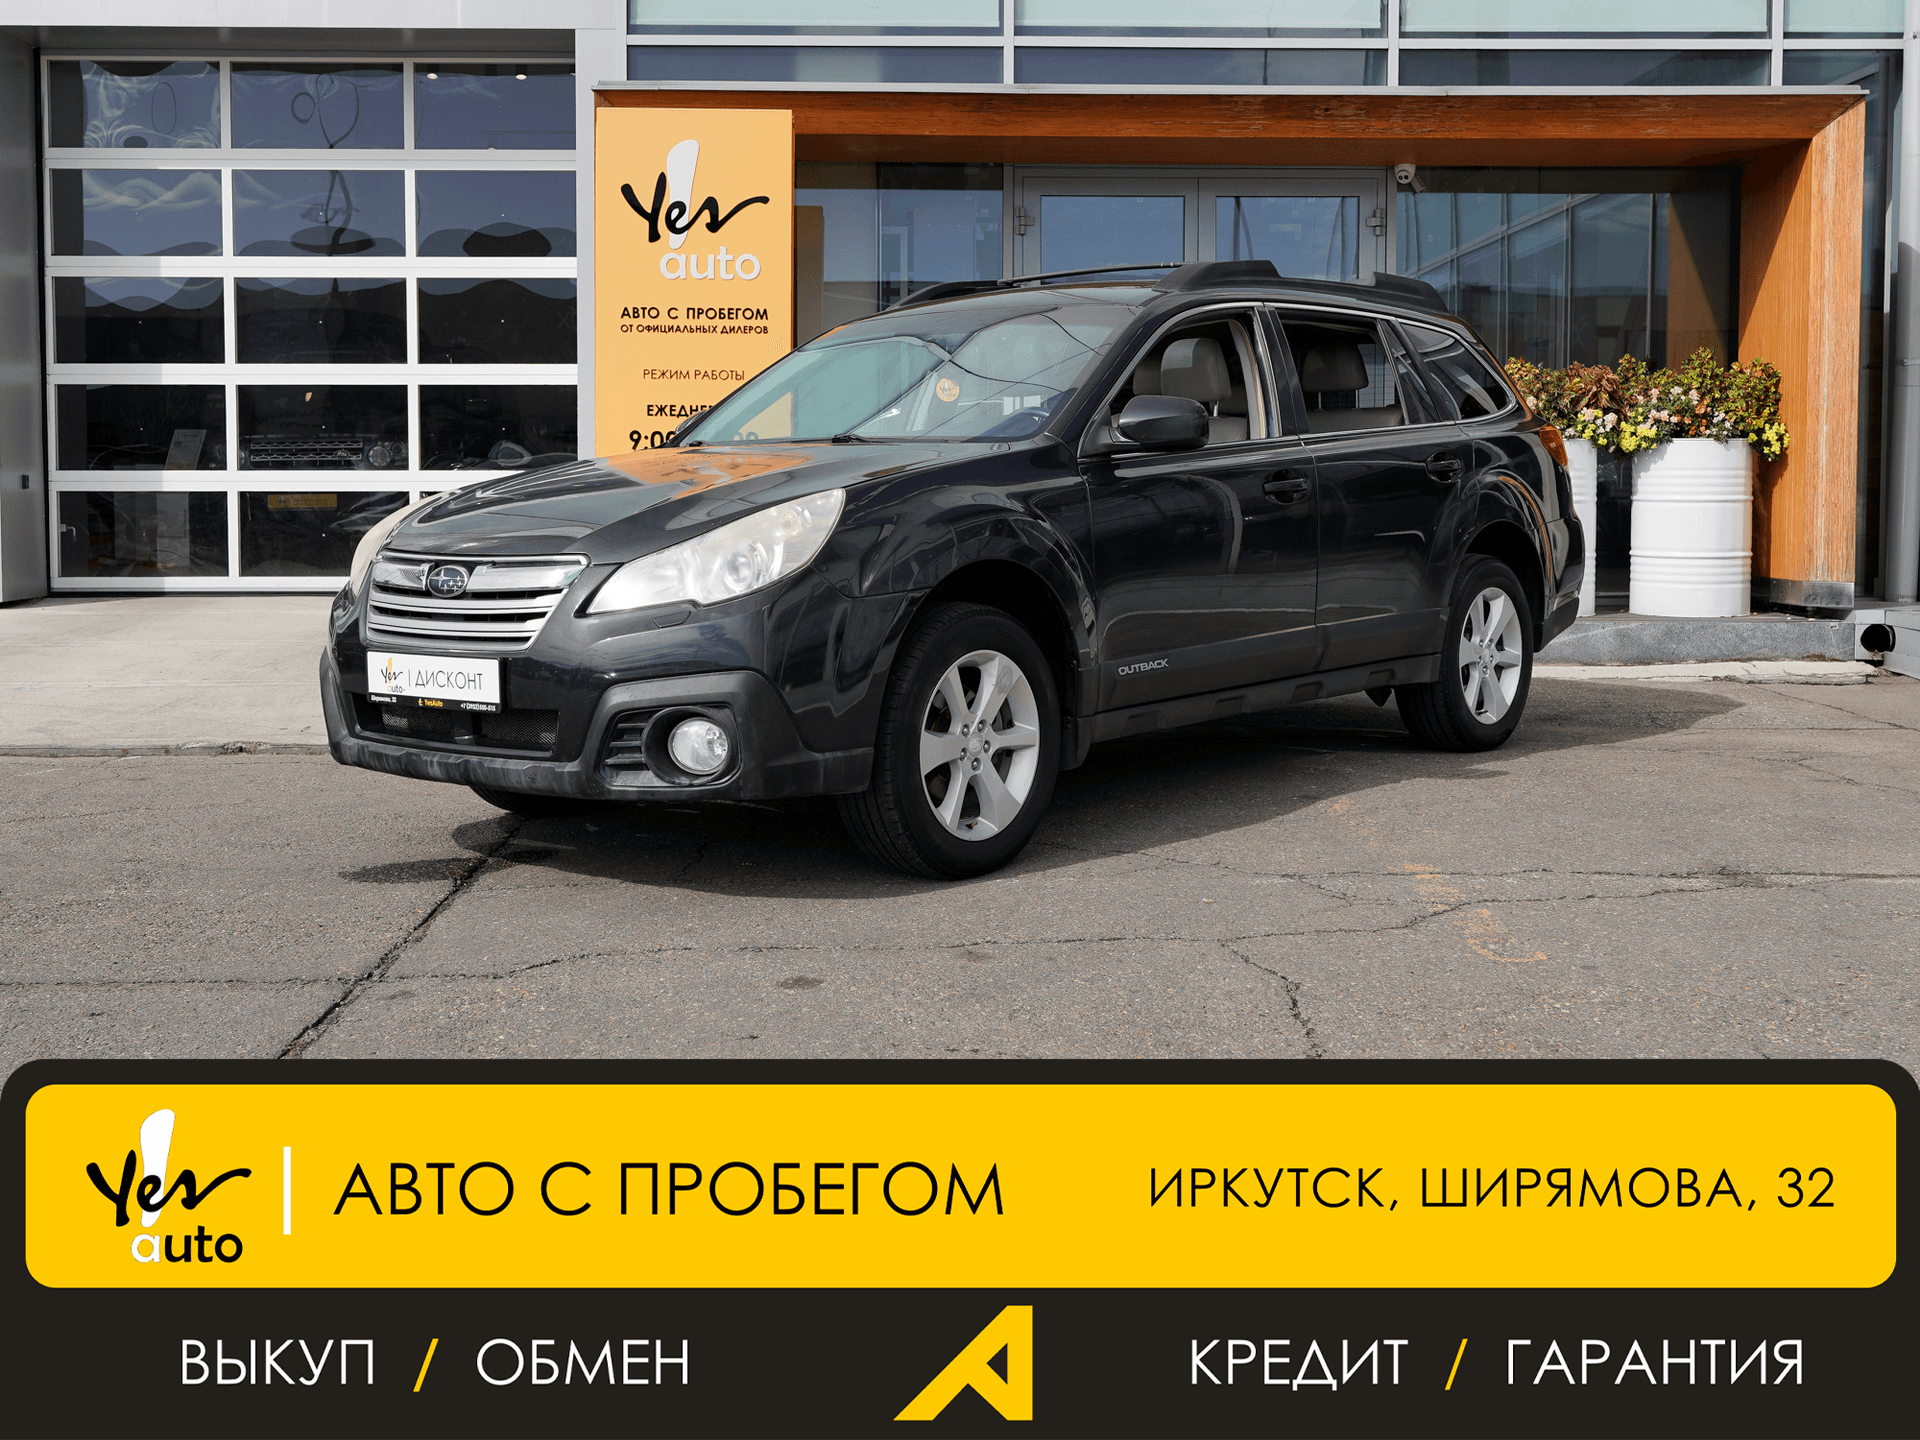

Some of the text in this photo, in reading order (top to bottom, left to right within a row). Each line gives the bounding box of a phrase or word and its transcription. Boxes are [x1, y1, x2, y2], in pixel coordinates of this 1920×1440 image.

[620, 170, 770, 243] Yes
[659, 246, 761, 280] auto
[620, 306, 769, 321] АВТО С ПРОБЕГОМ
[620, 324, 769, 335] ОТ ОФИЦИАЛЬНЫХ ДИЛЕРОВ
[643, 368, 745, 381] РЕЖИМ РАБОТЫ
[1118, 658, 1169, 675] OUTBACK
[415, 669, 483, 690] ДИСКОНТ
